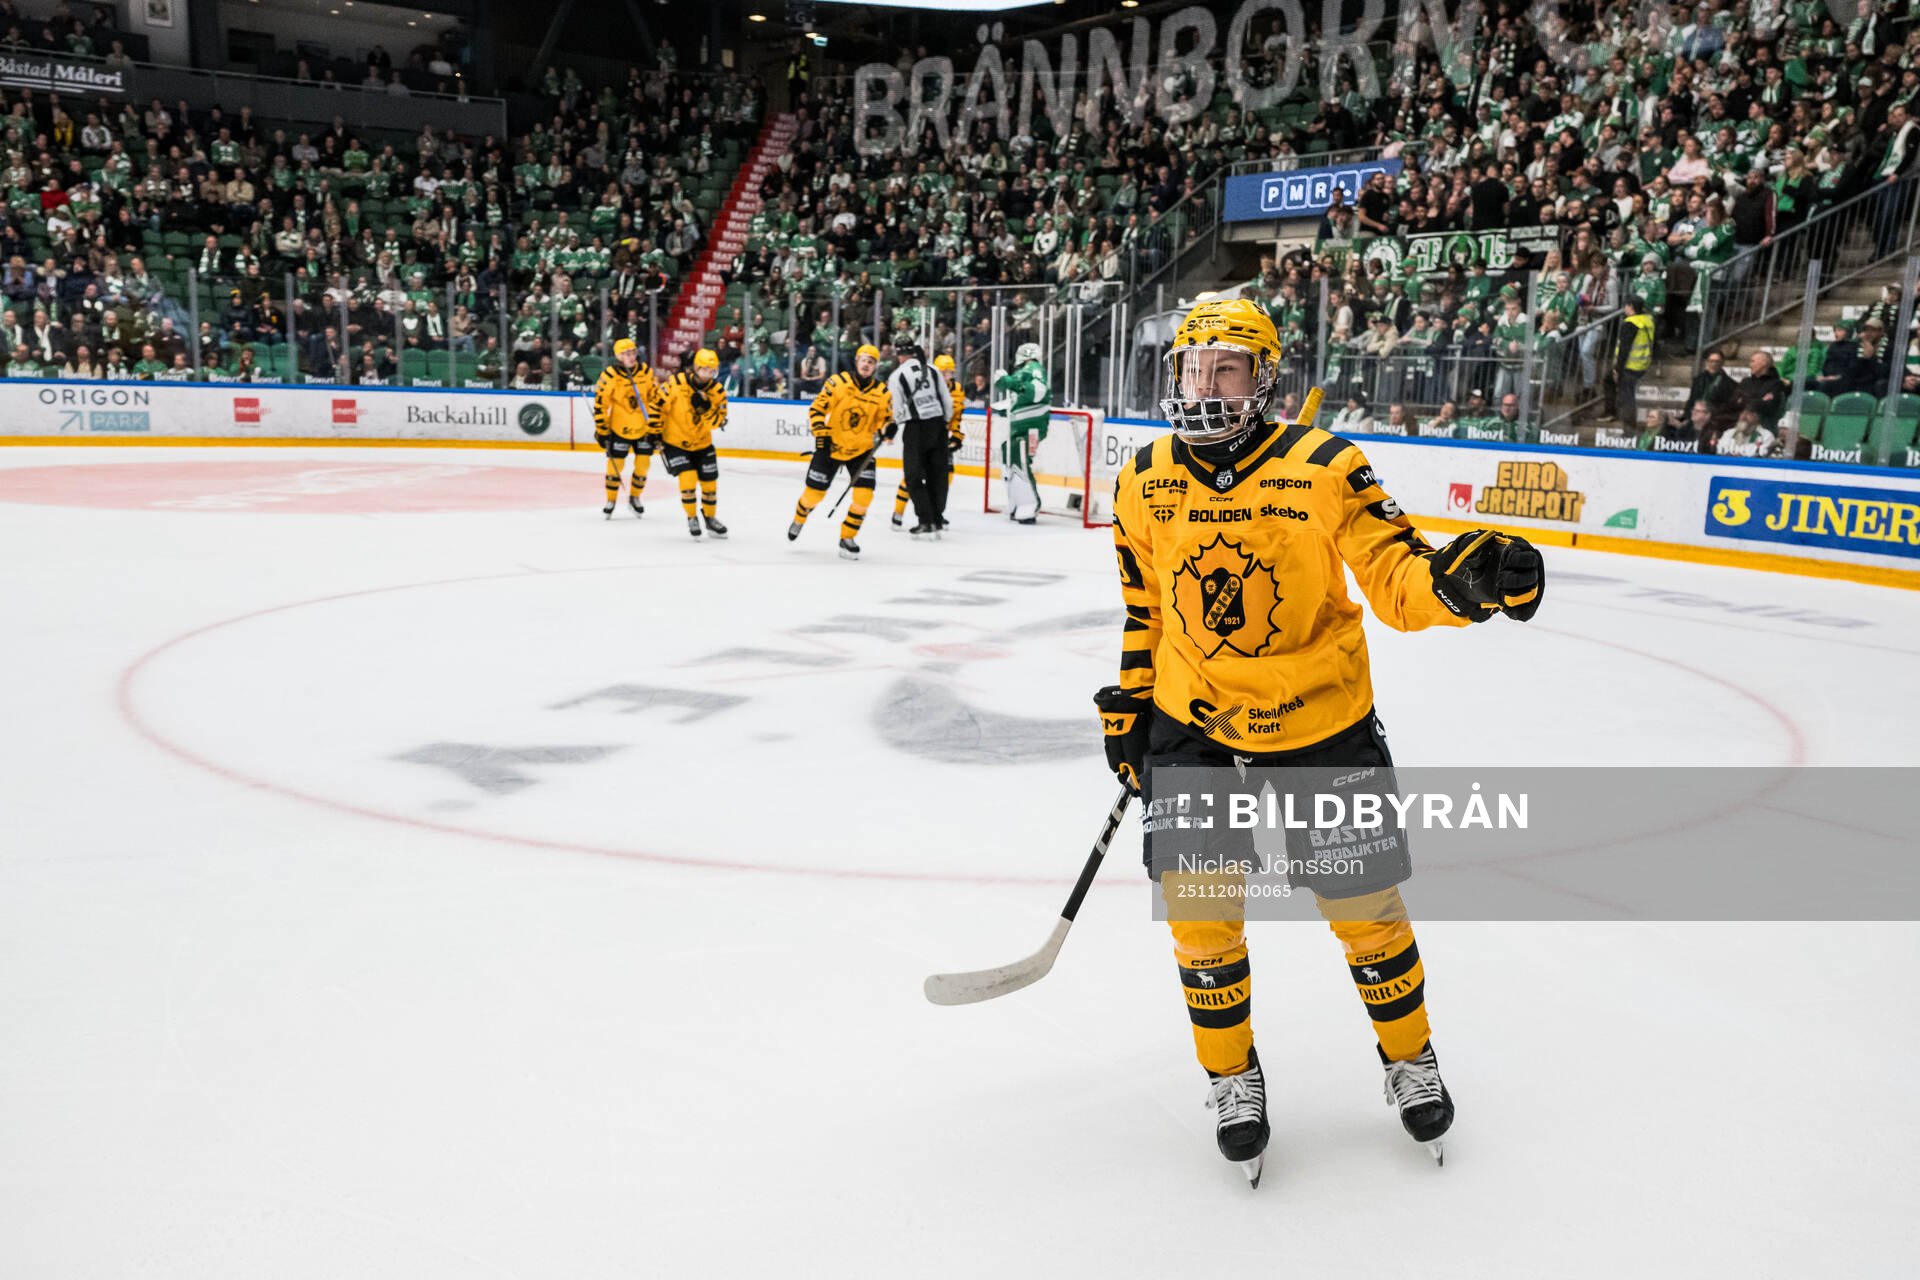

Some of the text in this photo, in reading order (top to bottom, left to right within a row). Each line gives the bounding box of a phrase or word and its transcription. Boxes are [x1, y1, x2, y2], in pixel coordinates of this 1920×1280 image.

[53, 64, 122, 86] Måleri
[39, 388, 150, 406] ORIGON
[93, 414, 145, 427] PARK
[407, 406, 507, 425] Backahill
[1373, 420, 1407, 436] Boozt
[1467, 425, 1504, 441] Boozt
[1540, 429, 1579, 446] Boozt
[1595, 431, 1638, 449] Boozt
[1653, 435, 1699, 454] Boozt
[1810, 444, 1861, 464] Boozt
[1216, 475, 1234, 489] 50
[1498, 461, 1560, 489] EURO
[1156, 479, 1188, 489] LEAB
[1259, 478, 1312, 490] engcon
[1260, 504, 1309, 521] skebo
[1475, 486, 1582, 523] JACKPOT
[1712, 489, 1751, 526] 3
[1188, 507, 1252, 523] BOLIDEN
[1437, 589, 1461, 613] CCM
[1224, 616, 1241, 625] 1921
[1248, 722, 1281, 734] Kraft
[1332, 767, 1376, 787] CCM
[1314, 836, 1398, 861] PRODUKTER
[1191, 957, 1223, 966] CCM
[1355, 951, 1386, 963] CCM
